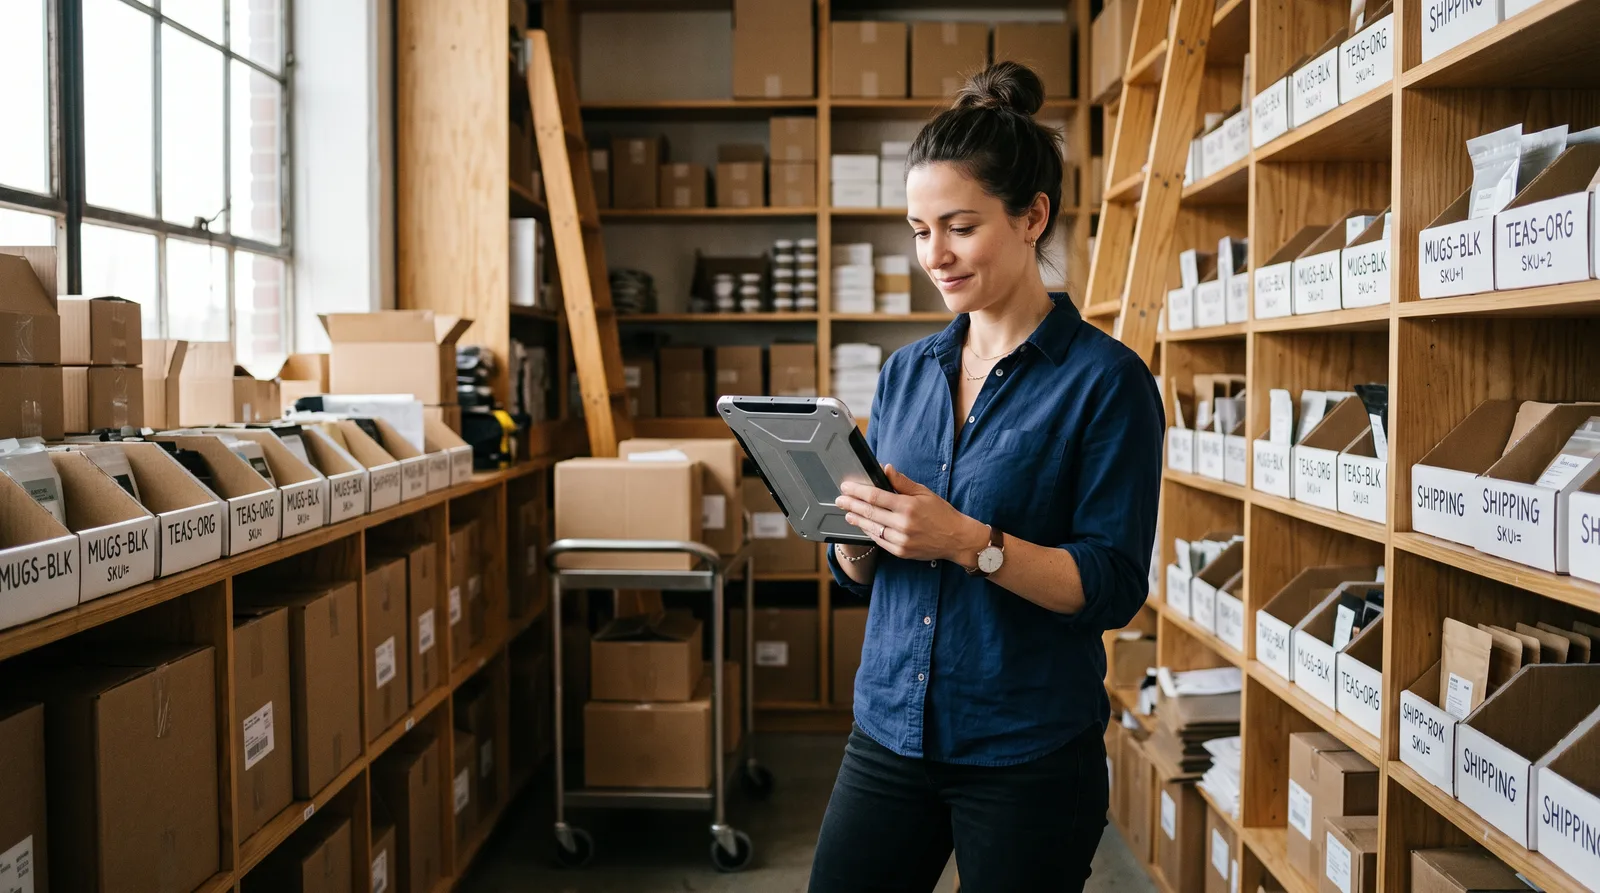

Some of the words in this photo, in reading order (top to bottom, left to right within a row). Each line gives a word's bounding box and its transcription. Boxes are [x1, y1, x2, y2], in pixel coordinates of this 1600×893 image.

[1430, 0, 1482, 32] SHIPPI
[1346, 28, 1387, 69] TEAS-ORG
[1296, 60, 1331, 96] MUGS-BLK
[1506, 210, 1574, 249] TEAS-ORG
[1348, 251, 1387, 276] MUGS-BLK
[1425, 230, 1482, 265] MUGS-BLK
[1521, 252, 1552, 272] SKU+2
[1299, 262, 1334, 287] MUGS-BLK
[1440, 266, 1464, 284] SKU+1
[1299, 458, 1331, 480] TEAS-ORG
[1343, 463, 1381, 488] TEAS-BLK
[287, 487, 320, 511] MUGS-BLK
[334, 475, 364, 499] MUGS-BLK
[1417, 485, 1465, 517] SHIPPING
[236, 499, 275, 526] TEAS-ORG
[1482, 488, 1540, 526] SHIPPING
[168, 514, 216, 545] TEAS-ORG
[88, 528, 149, 564] MUGS-BLK
[0, 550, 73, 592] MUGS-BLK
[1298, 648, 1331, 683] MUGS-BLK
[1342, 671, 1380, 711] TEAS-ORG
[1403, 702, 1445, 743] SHIPP-ROK
[1412, 735, 1431, 756] SKU=
[1464, 748, 1516, 802] SHIPPING
